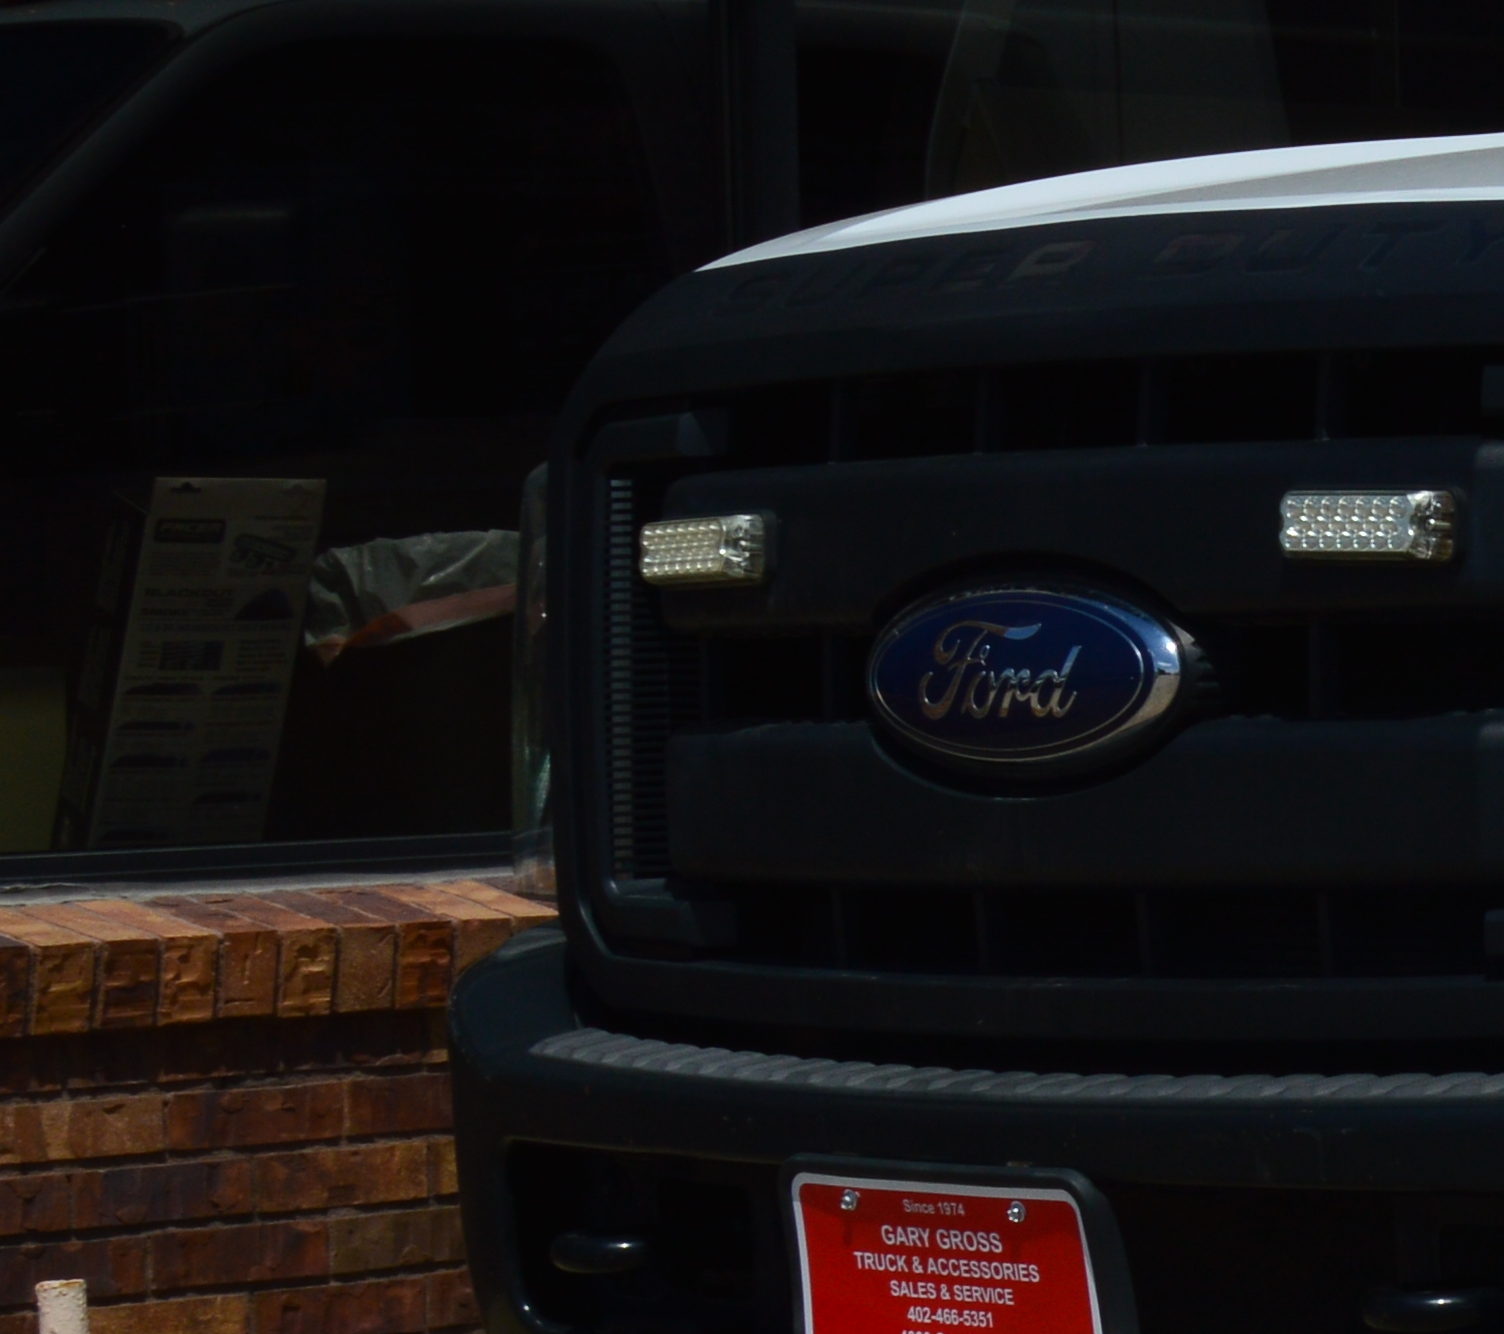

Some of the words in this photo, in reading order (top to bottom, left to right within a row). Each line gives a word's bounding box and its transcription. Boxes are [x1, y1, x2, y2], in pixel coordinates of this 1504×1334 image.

[918, 619, 1082, 720] Ford
[902, 1198, 935, 1215] Since
[937, 1202, 965, 1217] 1974
[881, 1225, 931, 1248] GARY
[936, 1229, 1003, 1254] GROSS
[853, 1251, 907, 1273] TRUCK
[912, 1257, 924, 1274] &
[927, 1257, 1040, 1283] ACCESSORIES
[890, 1280, 937, 1300] SALES
[941, 1284, 951, 1301] &
[953, 1285, 1015, 1306] SERVICE
[907, 1307, 994, 1328] 402-466-5351
